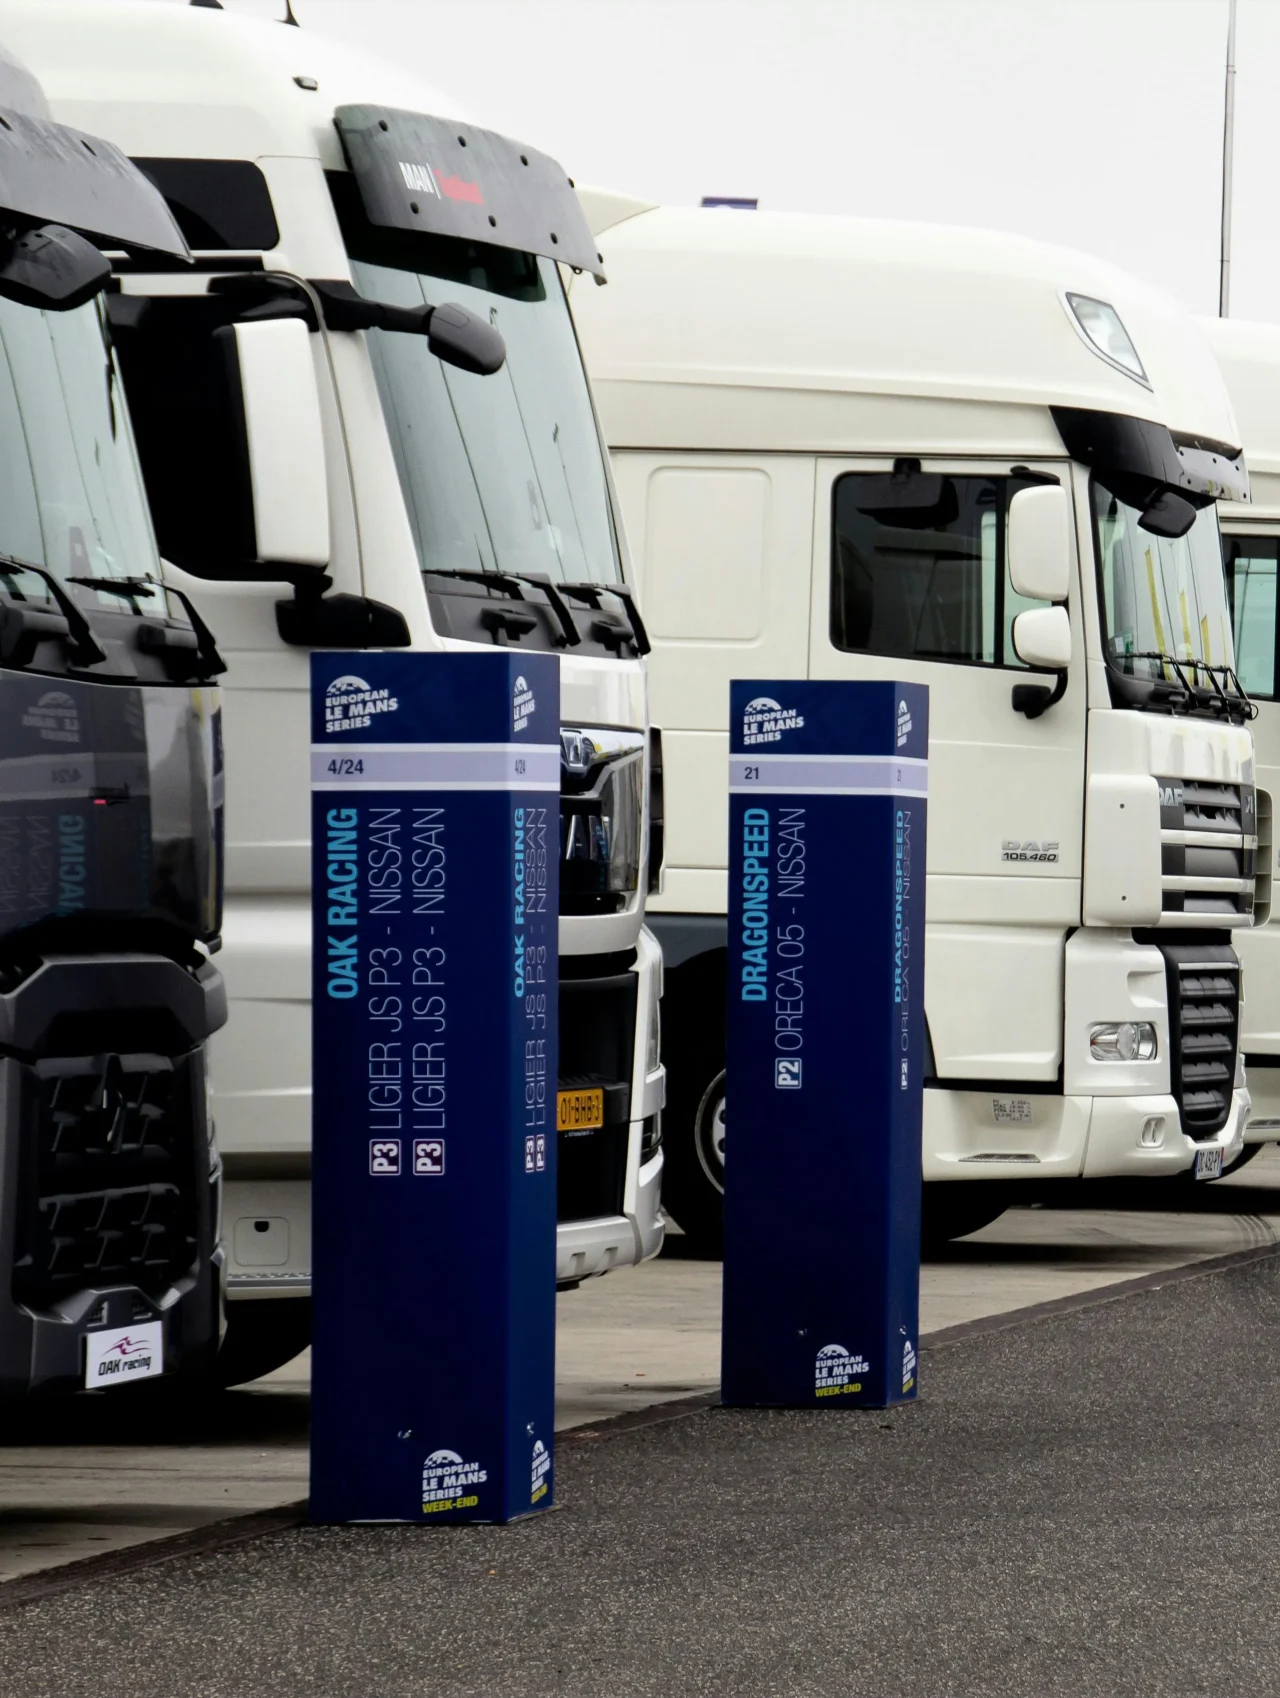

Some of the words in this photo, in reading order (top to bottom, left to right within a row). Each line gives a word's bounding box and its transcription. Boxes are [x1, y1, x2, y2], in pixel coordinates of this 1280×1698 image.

[398, 161, 434, 193] MAN
[325, 688, 389, 707] EUROPEAN
[325, 705, 343, 721] LE
[348, 697, 399, 717] MANS
[325, 715, 372, 733] SERIES
[743, 708, 797, 724] EUROPEAN
[743, 722, 758, 736] LE
[763, 716, 804, 733] MANS
[743, 731, 782, 745] SERIES
[327, 758, 364, 775] 4/24
[744, 766, 760, 780] 21
[368, 808, 402, 914] NISSAN
[412, 808, 446, 914] NISSAN
[525, 808, 537, 913] NISSAN
[536, 808, 548, 913] NISSAN
[777, 808, 806, 897] NISSAN
[1001, 840, 1059, 852] DAF
[1003, 852, 1057, 862] 105.460
[326, 807, 358, 925] RACING
[514, 807, 525, 925] RACING
[741, 808, 770, 1001] DRAGONSPEED
[894, 810, 904, 1003] DRAGONSPEED
[776, 924, 805, 958] 05
[327, 934, 358, 999] OAK
[368, 947, 402, 985] P3
[412, 947, 446, 985] P3
[514, 934, 525, 998] OAK
[525, 946, 536, 984] P3
[536, 945, 547, 983] P3
[368, 996, 402, 1032] JS
[412, 996, 446, 1032] JS
[525, 993, 536, 1030] JS
[536, 992, 547, 1029] JS
[775, 965, 804, 1051] ORECA
[368, 1042, 402, 1128] LIGIER
[412, 1042, 446, 1128] LIGIER
[525, 1039, 536, 1126] LIGIER
[536, 1038, 547, 1125] LIGIER
[778, 1060, 799, 1086] P2
[372, 1142, 398, 1172] P3
[416, 1142, 442, 1172] P3
[98, 1359, 121, 1377] OAK
[122, 1354, 152, 1371] racing
[815, 1355, 863, 1368] EUROPEAN
[815, 1368, 828, 1379] LE
[832, 1362, 870, 1376] MANS
[815, 1375, 849, 1388] SERIES
[815, 1383, 862, 1397] WEEK-END
[422, 1462, 479, 1478] EUROPEAN
[422, 1478, 438, 1491] LE
[442, 1470, 488, 1488] MANS
[422, 1486, 463, 1502] SERIES
[422, 1496, 479, 1514] WEEK-END
